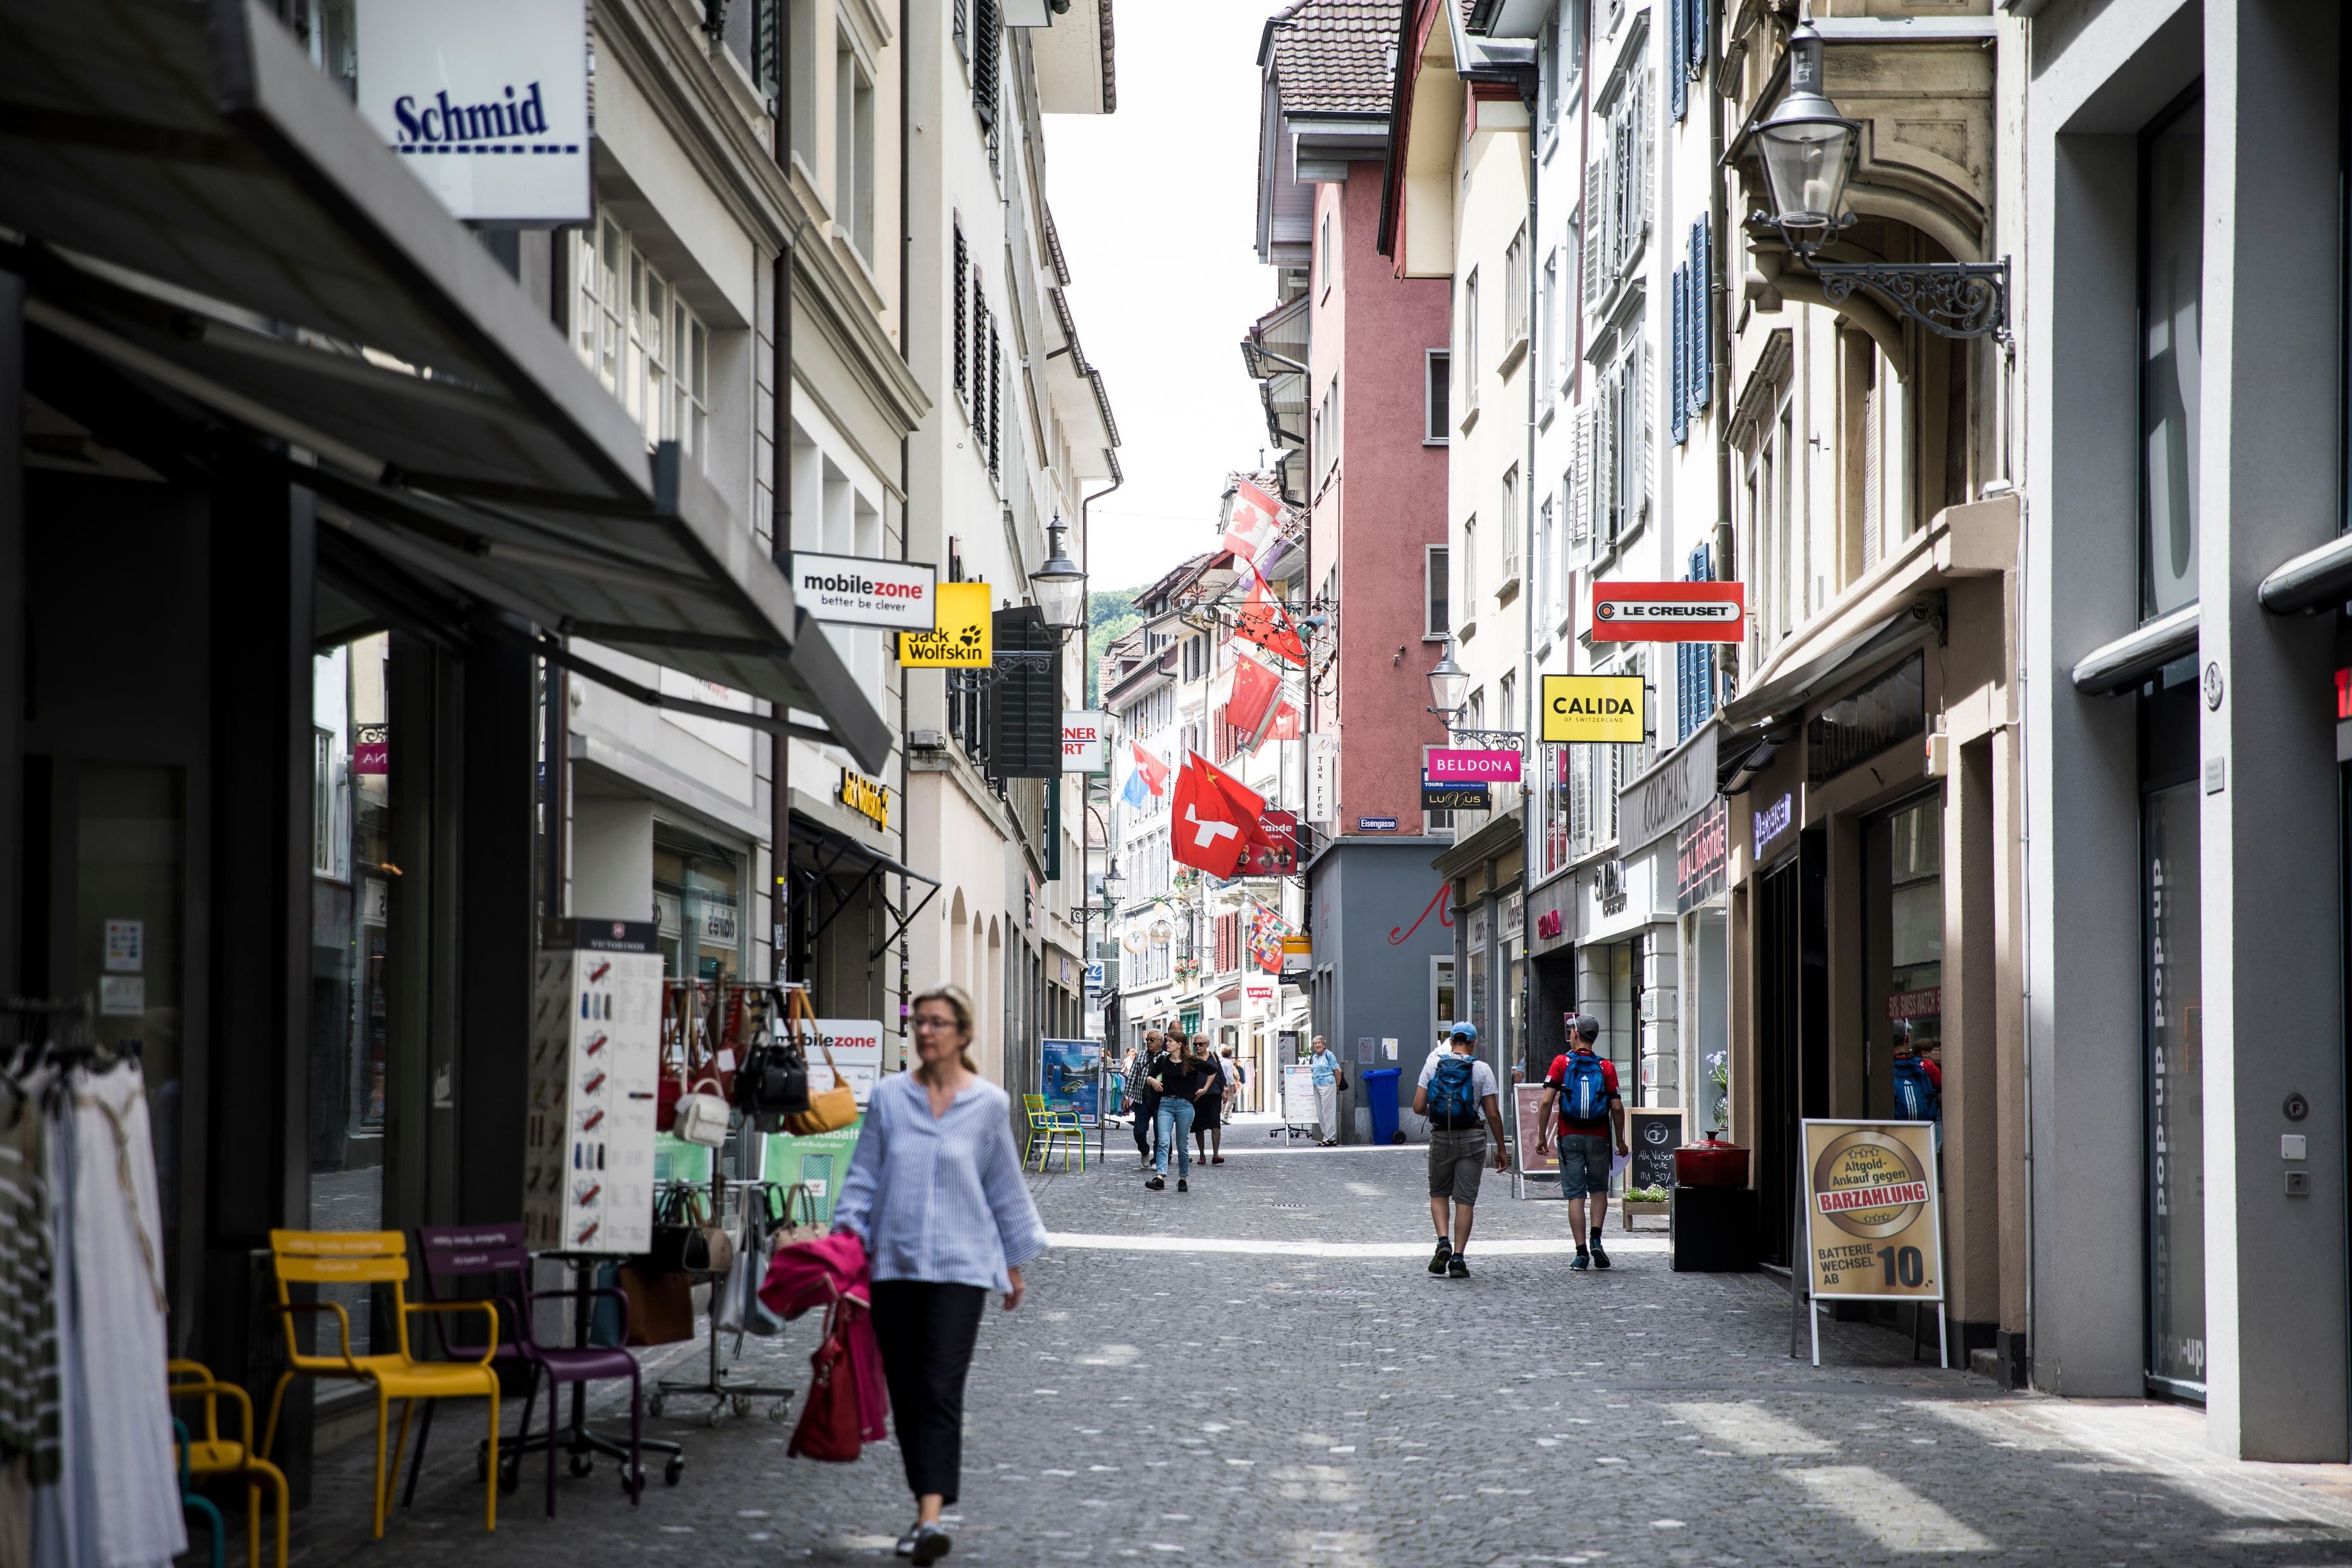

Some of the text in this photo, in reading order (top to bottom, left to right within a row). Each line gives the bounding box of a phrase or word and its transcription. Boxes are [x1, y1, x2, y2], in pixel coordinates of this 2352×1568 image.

[395, 81, 549, 143] Schmid
[804, 573, 923, 599] mobilezone
[821, 595, 906, 611] better be clever
[1623, 606, 1729, 616] LE CREUSET
[909, 644, 982, 659] Wolfskin
[1553, 697, 1635, 715] CALIDA
[1436, 759, 1513, 771] BELDONA
[1645, 755, 1689, 832] GOLDHAUS
[1361, 819, 1395, 829] Eisengasse
[590, 938, 646, 951] VICTORINOX
[2153, 858, 2165, 1027] pop-up
[1901, 994, 1916, 1017] SWISS
[1917, 991, 1935, 1014] WATCH
[2155, 1045, 2167, 1216] pop-up
[1650, 1159, 1668, 1170] heute
[1845, 1158, 1887, 1173] Altgold-
[1832, 1170, 1906, 1187] Ankauf gegen
[1820, 1183, 1926, 1211] BARZAHLUNG
[1818, 1243, 1874, 1259] BATTERIE
[1820, 1256, 1875, 1272] WECHSEL
[1823, 1273, 1839, 1285] AB
